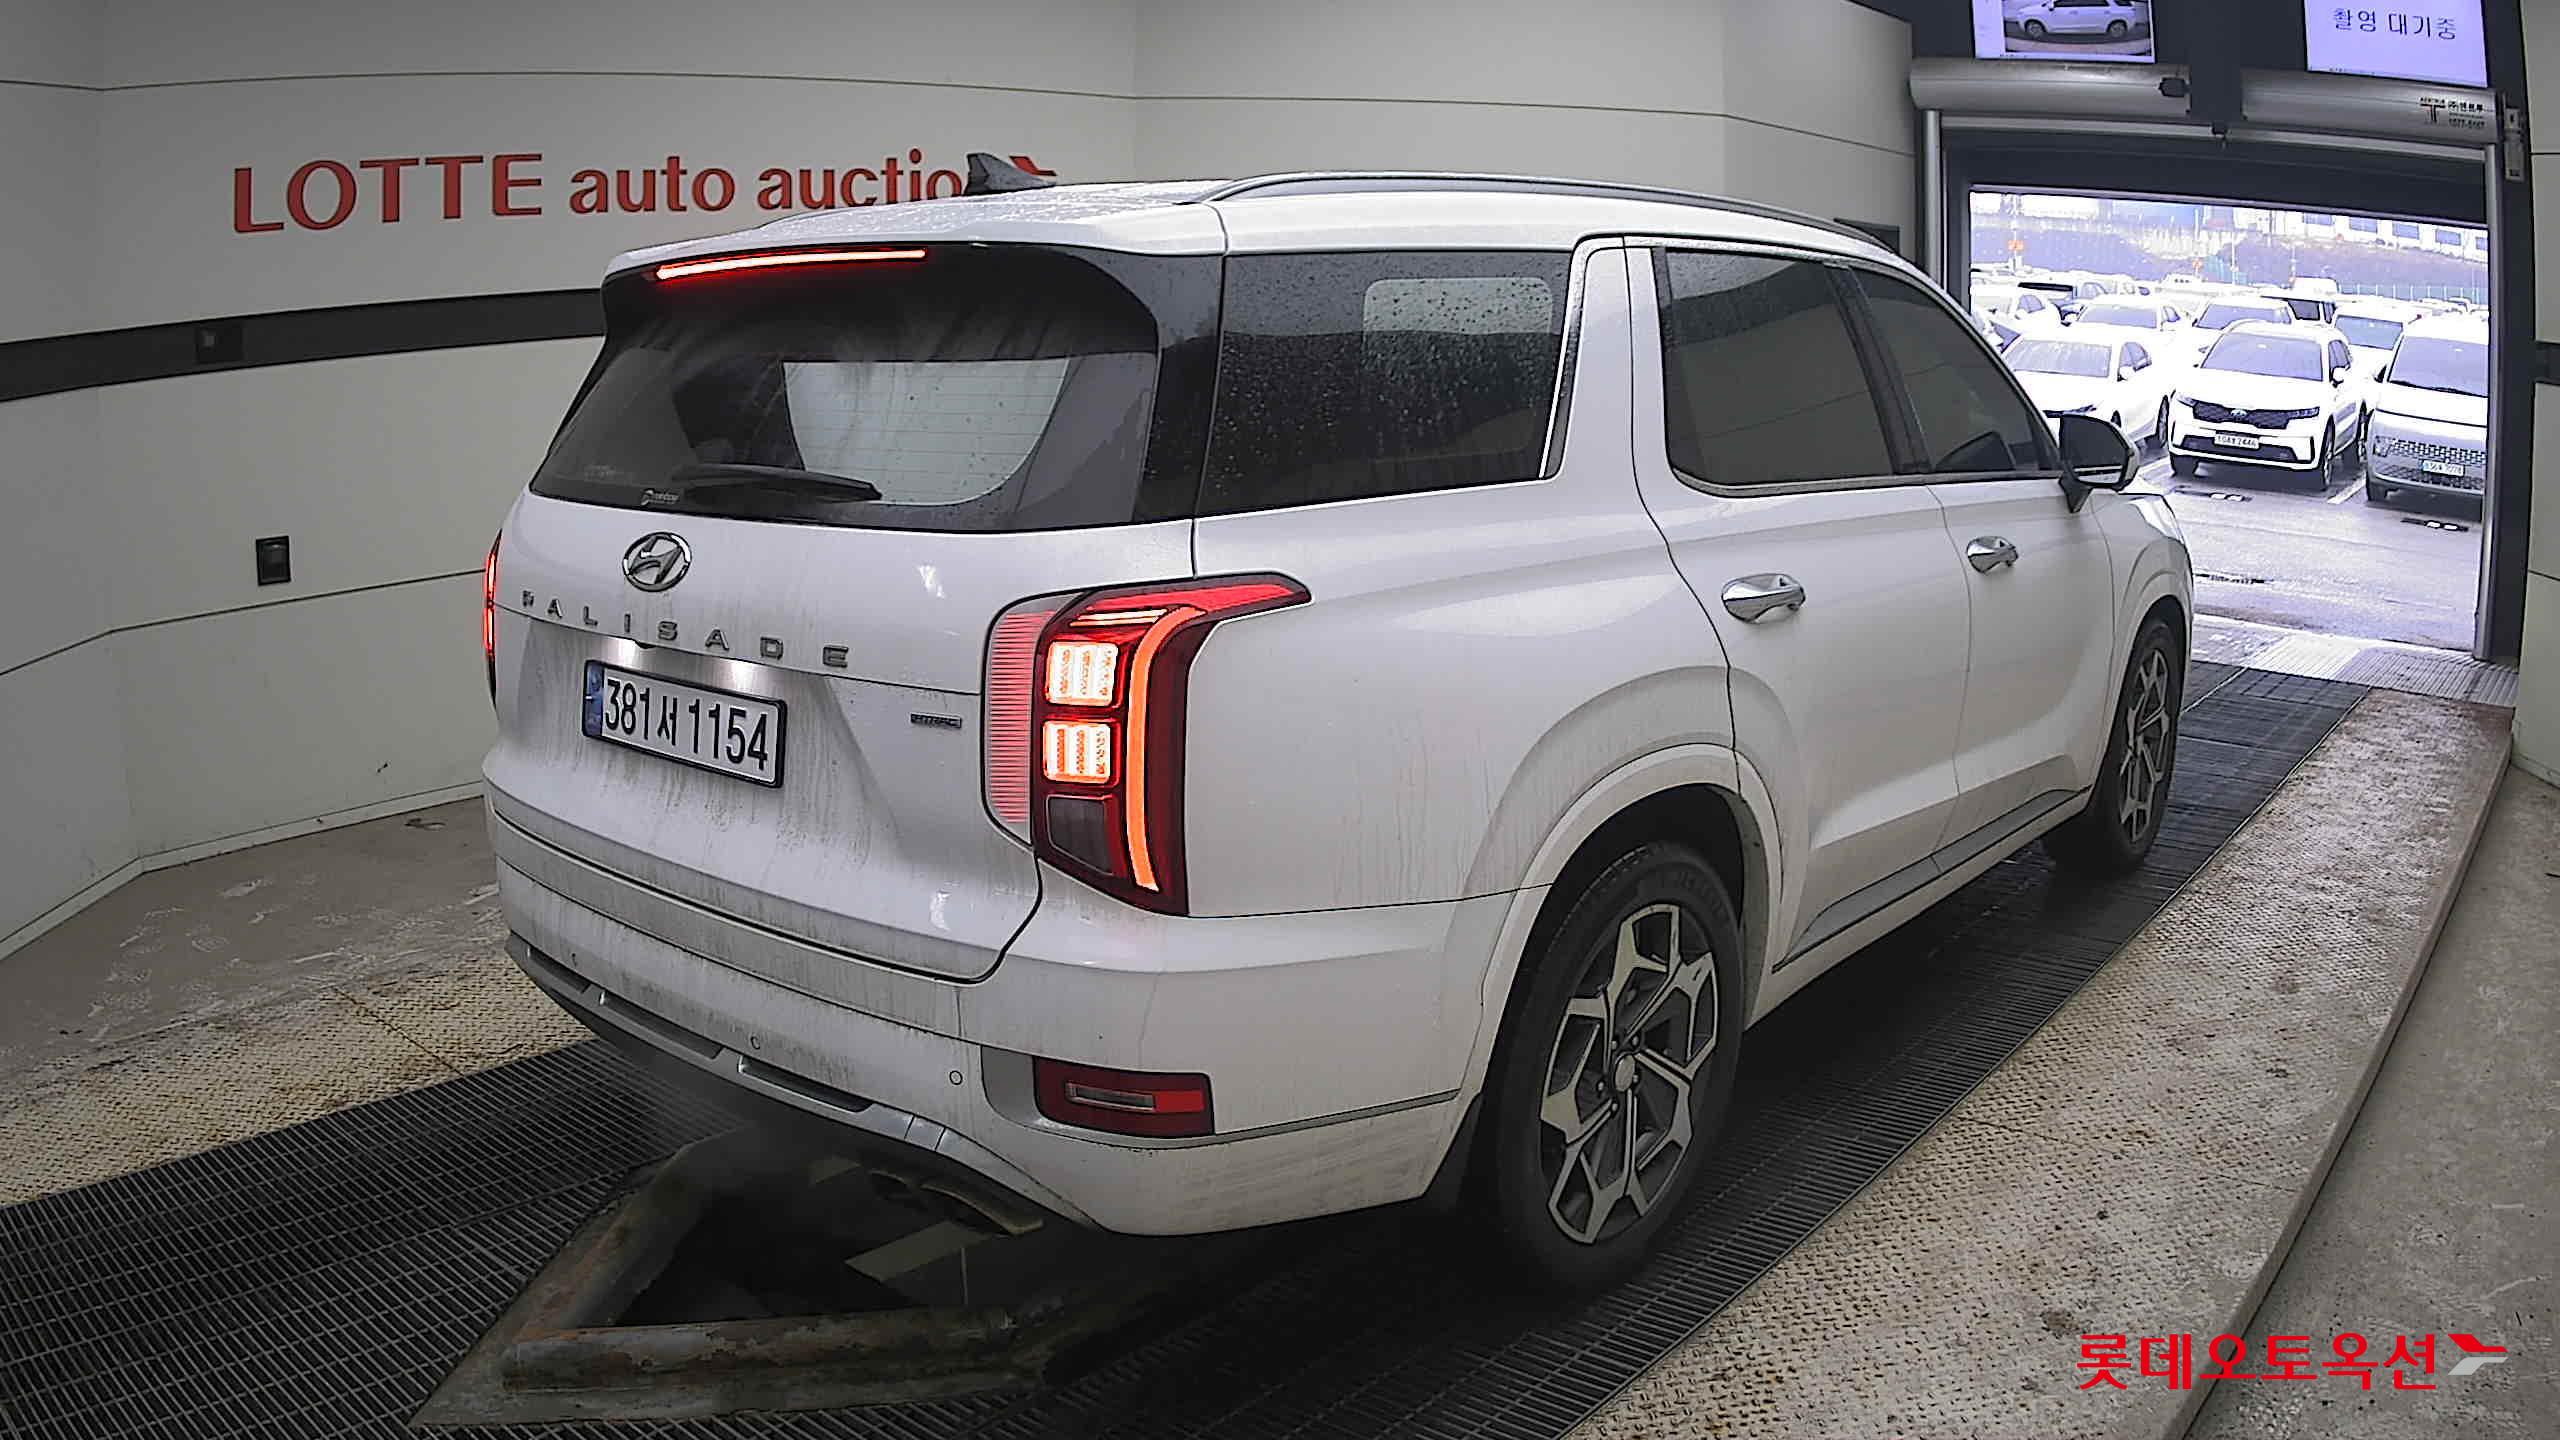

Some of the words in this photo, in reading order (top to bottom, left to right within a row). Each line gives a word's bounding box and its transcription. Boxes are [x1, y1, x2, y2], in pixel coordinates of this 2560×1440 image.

[2333, 8, 2377, 32] 촬영
[2387, 13, 2457, 40] 대기중
[234, 153, 542, 233] LOTTE
[569, 154, 736, 213] auto
[757, 148, 968, 211] auctio
[522, 590, 849, 668] PALISADE
[605, 678, 678, 746] 381서
[688, 698, 768, 771] 1154
